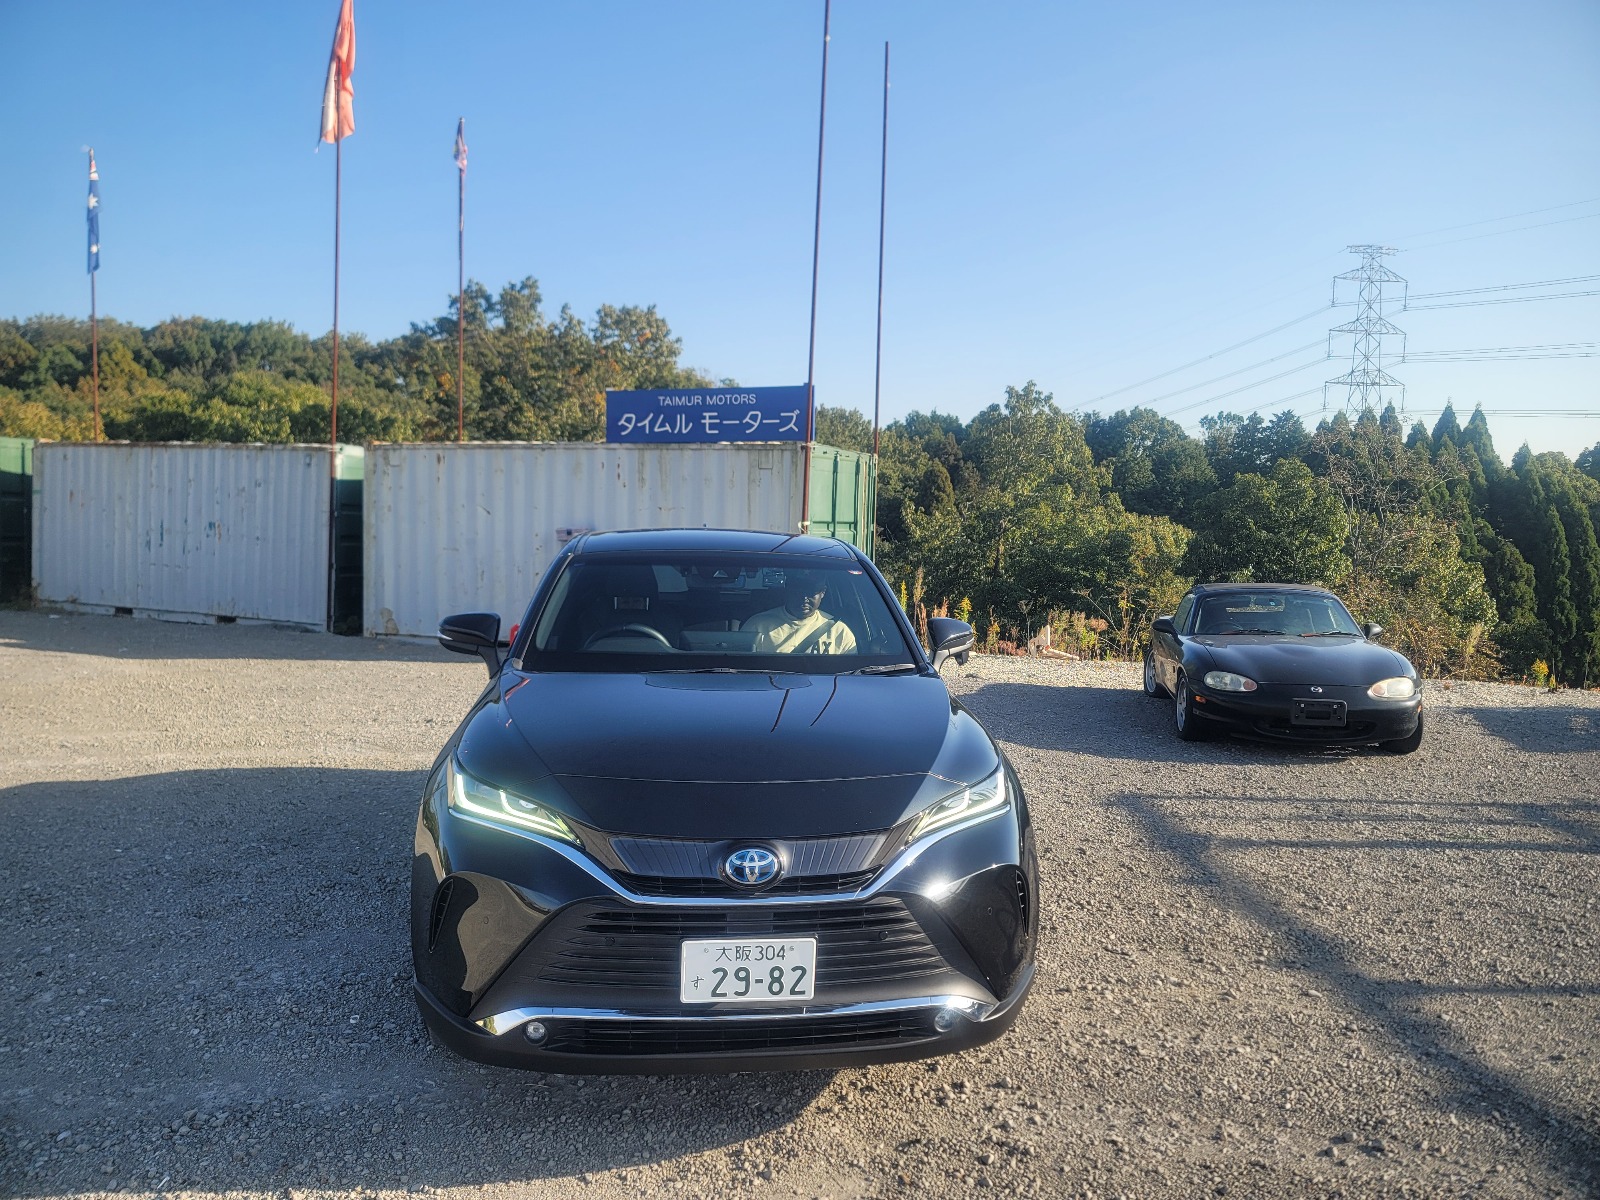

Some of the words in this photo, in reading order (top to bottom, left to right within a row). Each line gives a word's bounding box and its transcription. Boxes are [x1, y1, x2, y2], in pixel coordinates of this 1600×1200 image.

[658, 395, 702, 406] TAIMUR
[706, 394, 756, 405] MOTORS
[618, 412, 693, 436] タイムル
[701, 409, 800, 434] モーターズ
[711, 966, 807, 998] 29-82
